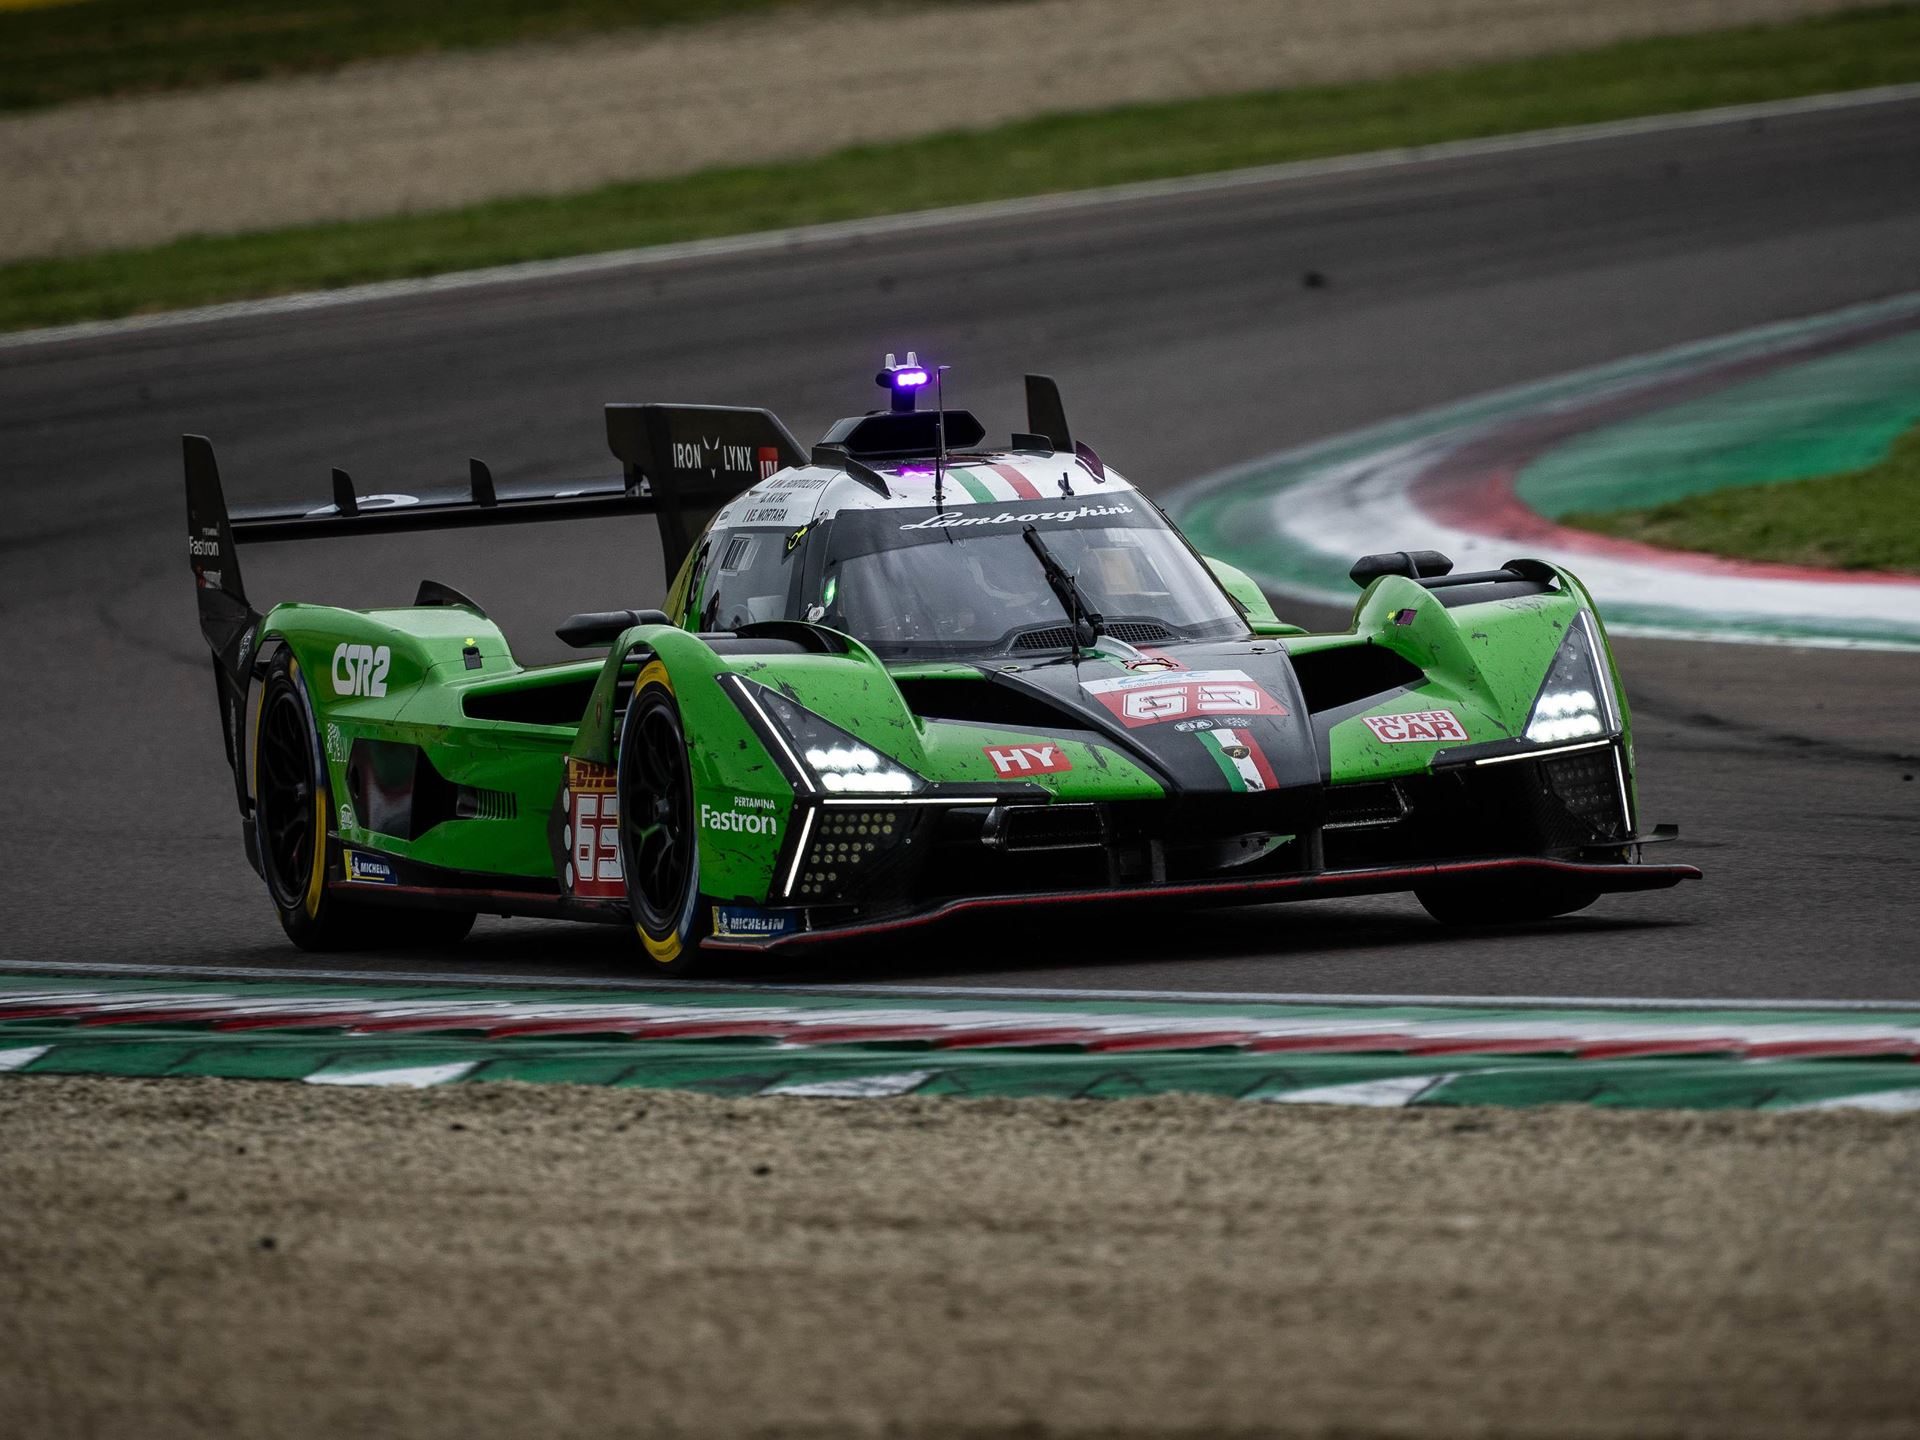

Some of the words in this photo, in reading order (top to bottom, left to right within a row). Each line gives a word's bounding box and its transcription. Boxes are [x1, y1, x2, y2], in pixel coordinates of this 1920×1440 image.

[673, 443, 702, 469] IRON
[723, 445, 753, 472] LYNX
[899, 503, 1134, 530] Lamborghini
[188, 536, 219, 556] Fastron
[332, 642, 391, 697] CSR2
[1123, 685, 1260, 719] 63
[1175, 719, 1213, 732] FIA
[1368, 711, 1450, 726] HYPER
[1378, 721, 1462, 740] CAR
[989, 746, 1055, 772] HY
[734, 796, 775, 810] PERTAMINA
[701, 804, 777, 835] Fastron
[360, 862, 390, 875] MICHELIN
[730, 917, 785, 930] MICHELIN
